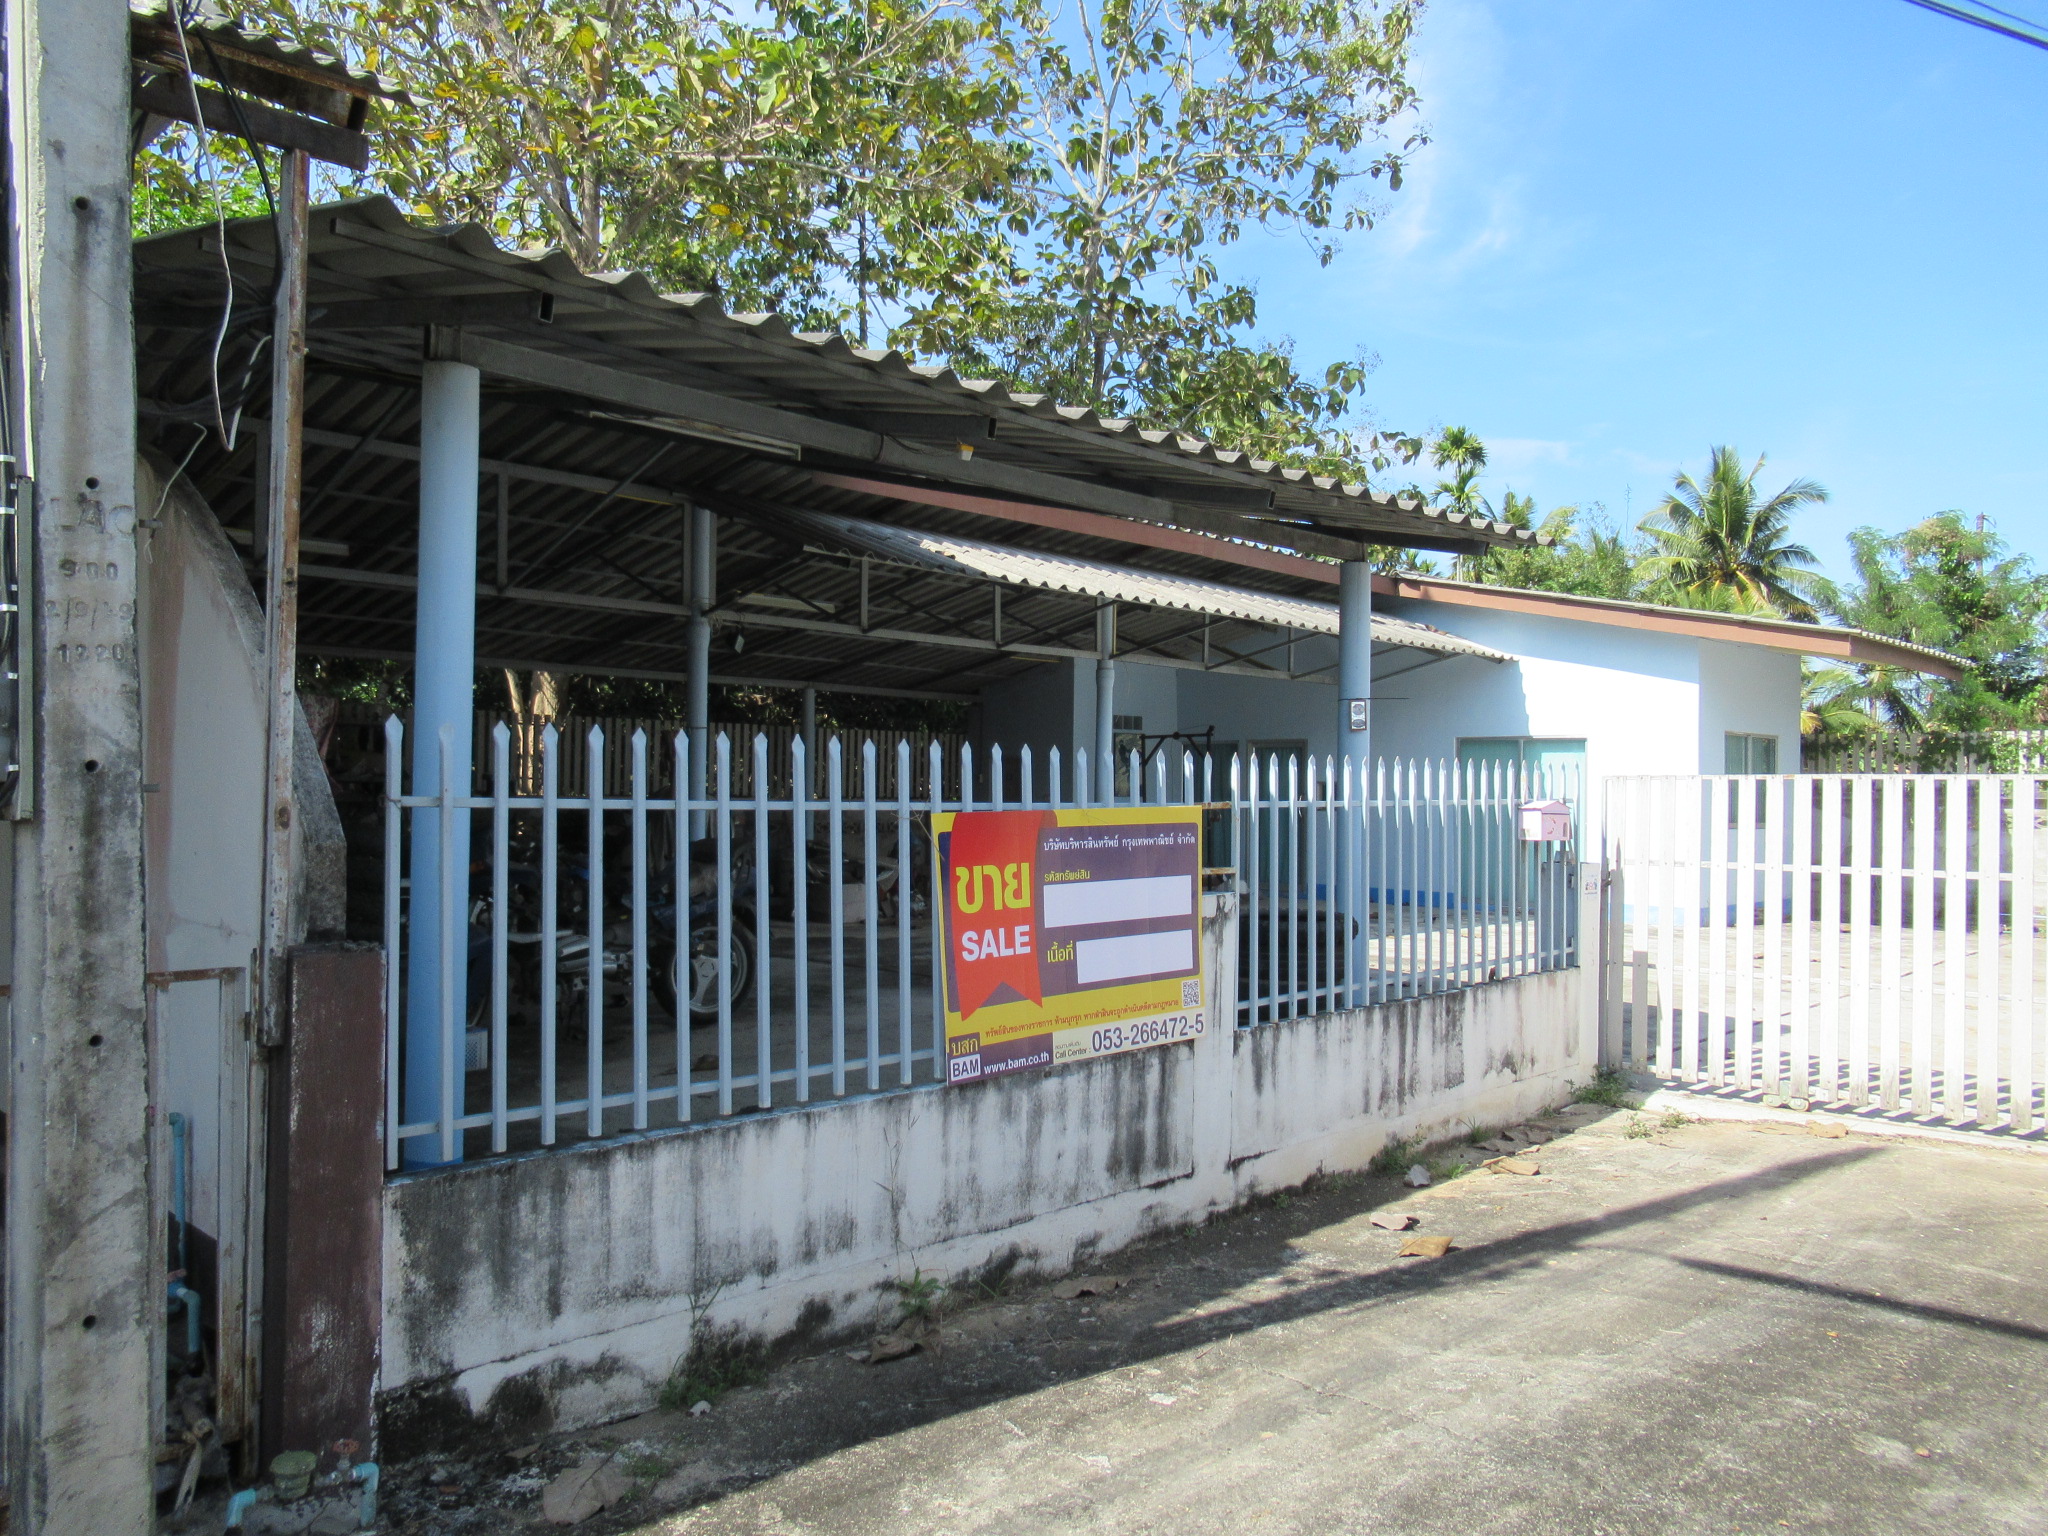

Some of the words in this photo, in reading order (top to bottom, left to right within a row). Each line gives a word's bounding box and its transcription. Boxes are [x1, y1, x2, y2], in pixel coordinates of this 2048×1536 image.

[1043, 834, 1119, 851] บริษัทบริหารสินทรัพย์
[1122, 832, 1174, 851] กรุงเทพพาณิชย์
[1177, 832, 1196, 845] จำกัด
[1044, 868, 1091, 882] รหัสทรัพย์สิน
[955, 862, 1031, 914] ขาย
[961, 925, 1031, 962] SALE
[1047, 940, 1074, 963] เนื้อที่
[1092, 1013, 1204, 1053] 053-266472-5
[951, 1037, 979, 1056] บสก
[1055, 1050, 1067, 1059] Call
[1067, 1048, 1087, 1057] Center
[952, 1057, 979, 1078] BAM
[984, 1051, 1050, 1075] www.bam.co.th
